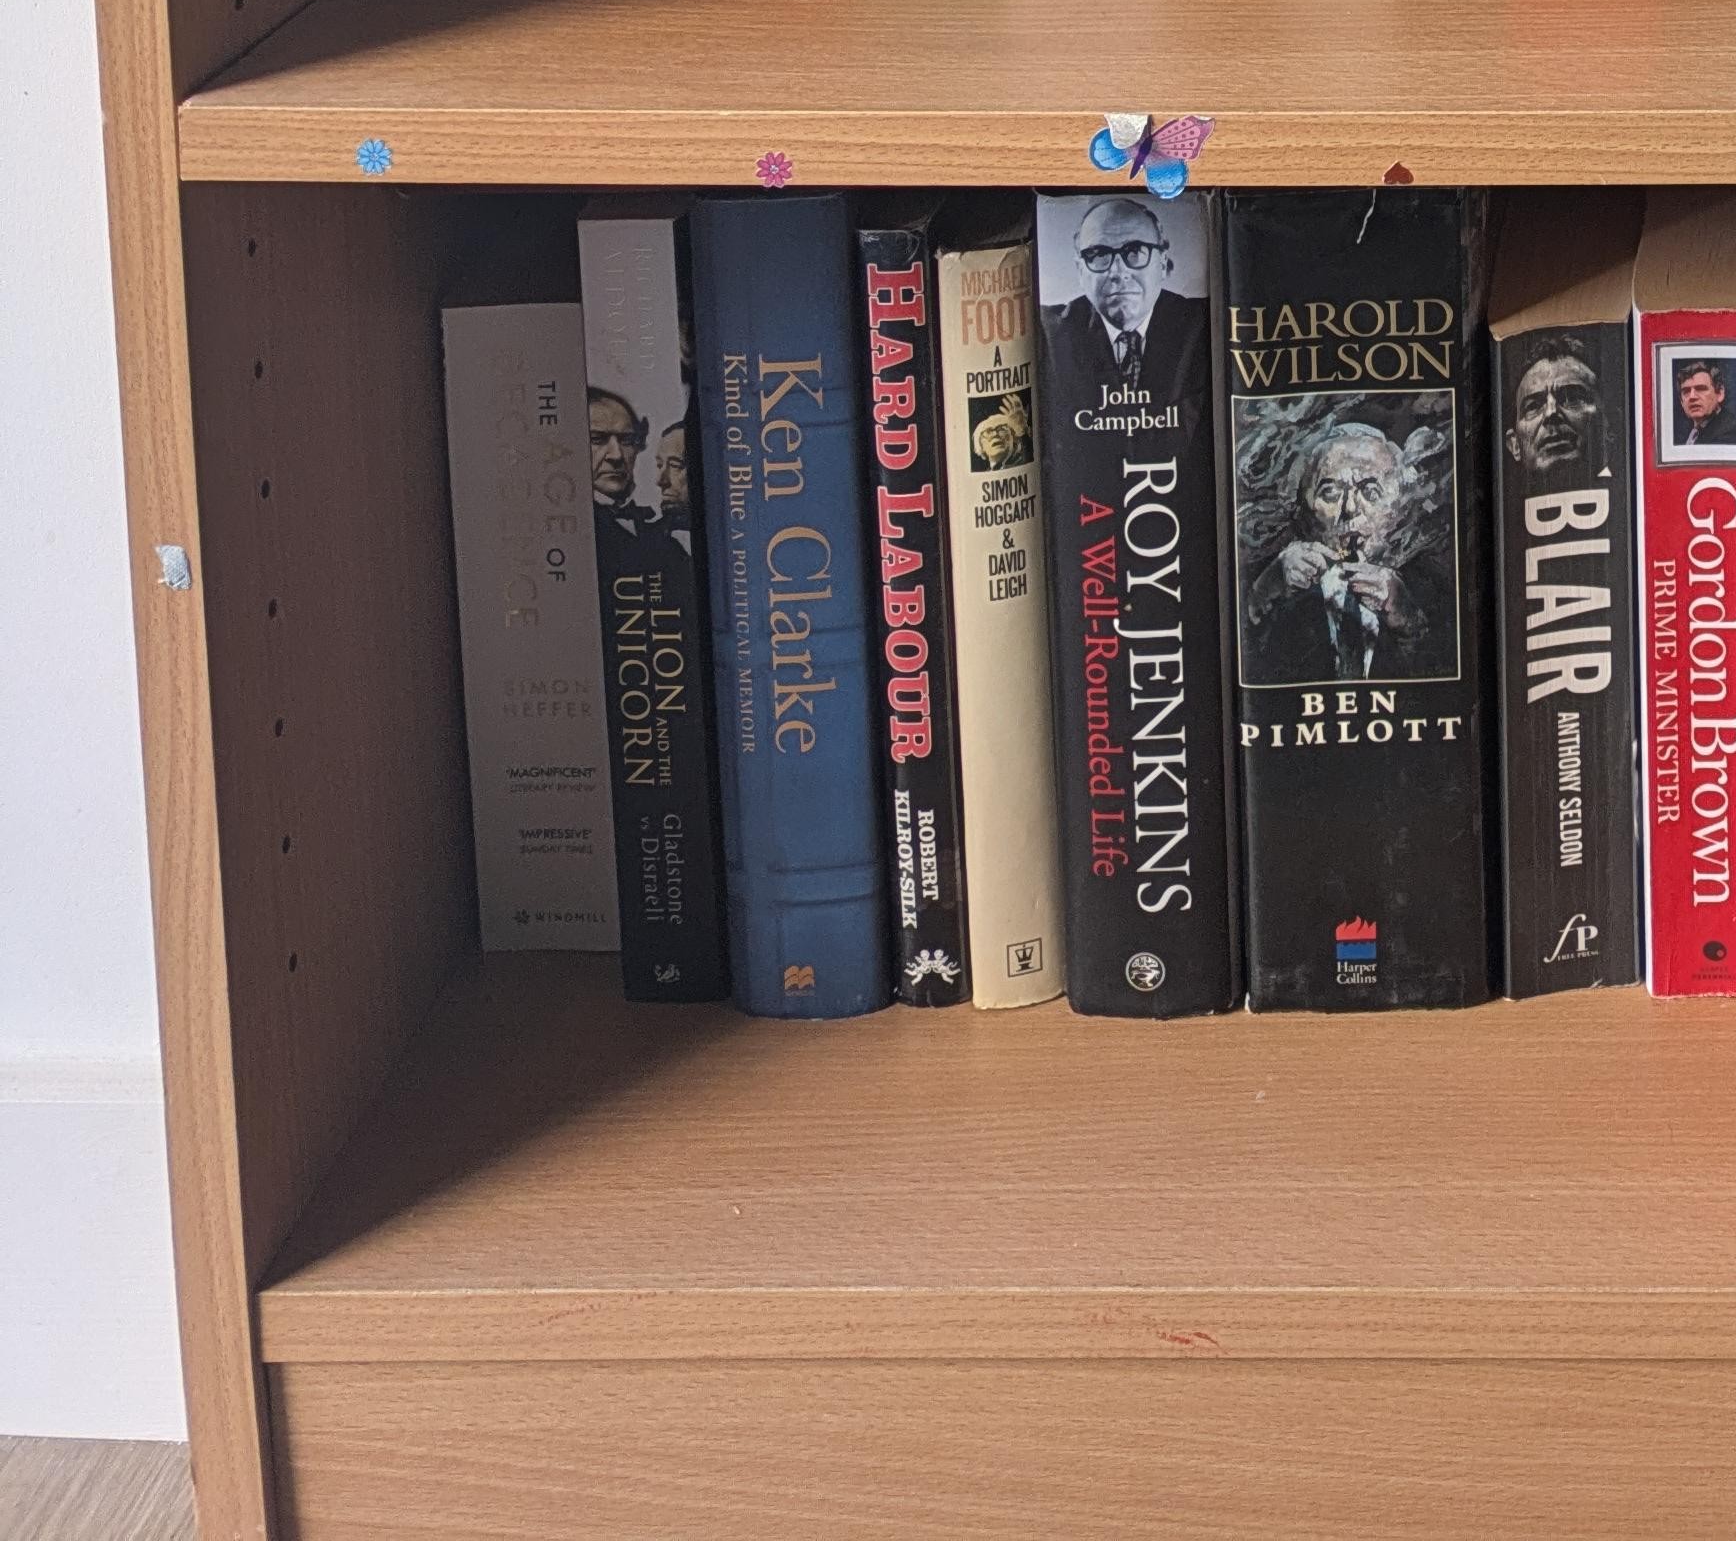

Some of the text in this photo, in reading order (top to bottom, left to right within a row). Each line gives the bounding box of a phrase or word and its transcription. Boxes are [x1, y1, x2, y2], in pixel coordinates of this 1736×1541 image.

[1230, 298, 1453, 342] HAROLD
[993, 347, 1003, 365] A
[1232, 342, 1452, 387] WILSON
[966, 367, 1032, 391] PORTRAIT
[1099, 384, 1151, 406] John
[1075, 407, 1179, 432] Campbell
[981, 481, 1028, 503] SIMON
[867, 262, 934, 764] HARD LABOUR
[974, 496, 1035, 527] HOGGART
[1001, 533, 1015, 550] &
[758, 355, 838, 755] Ken Clarke
[989, 550, 1026, 576] DAVID
[989, 574, 1028, 599] LEIGH
[1302, 691, 1398, 715] BEN
[1242, 718, 1462, 747] PIMLOTT
[1336, 962, 1377, 975] Harper
[1336, 972, 1377, 985] Collins
